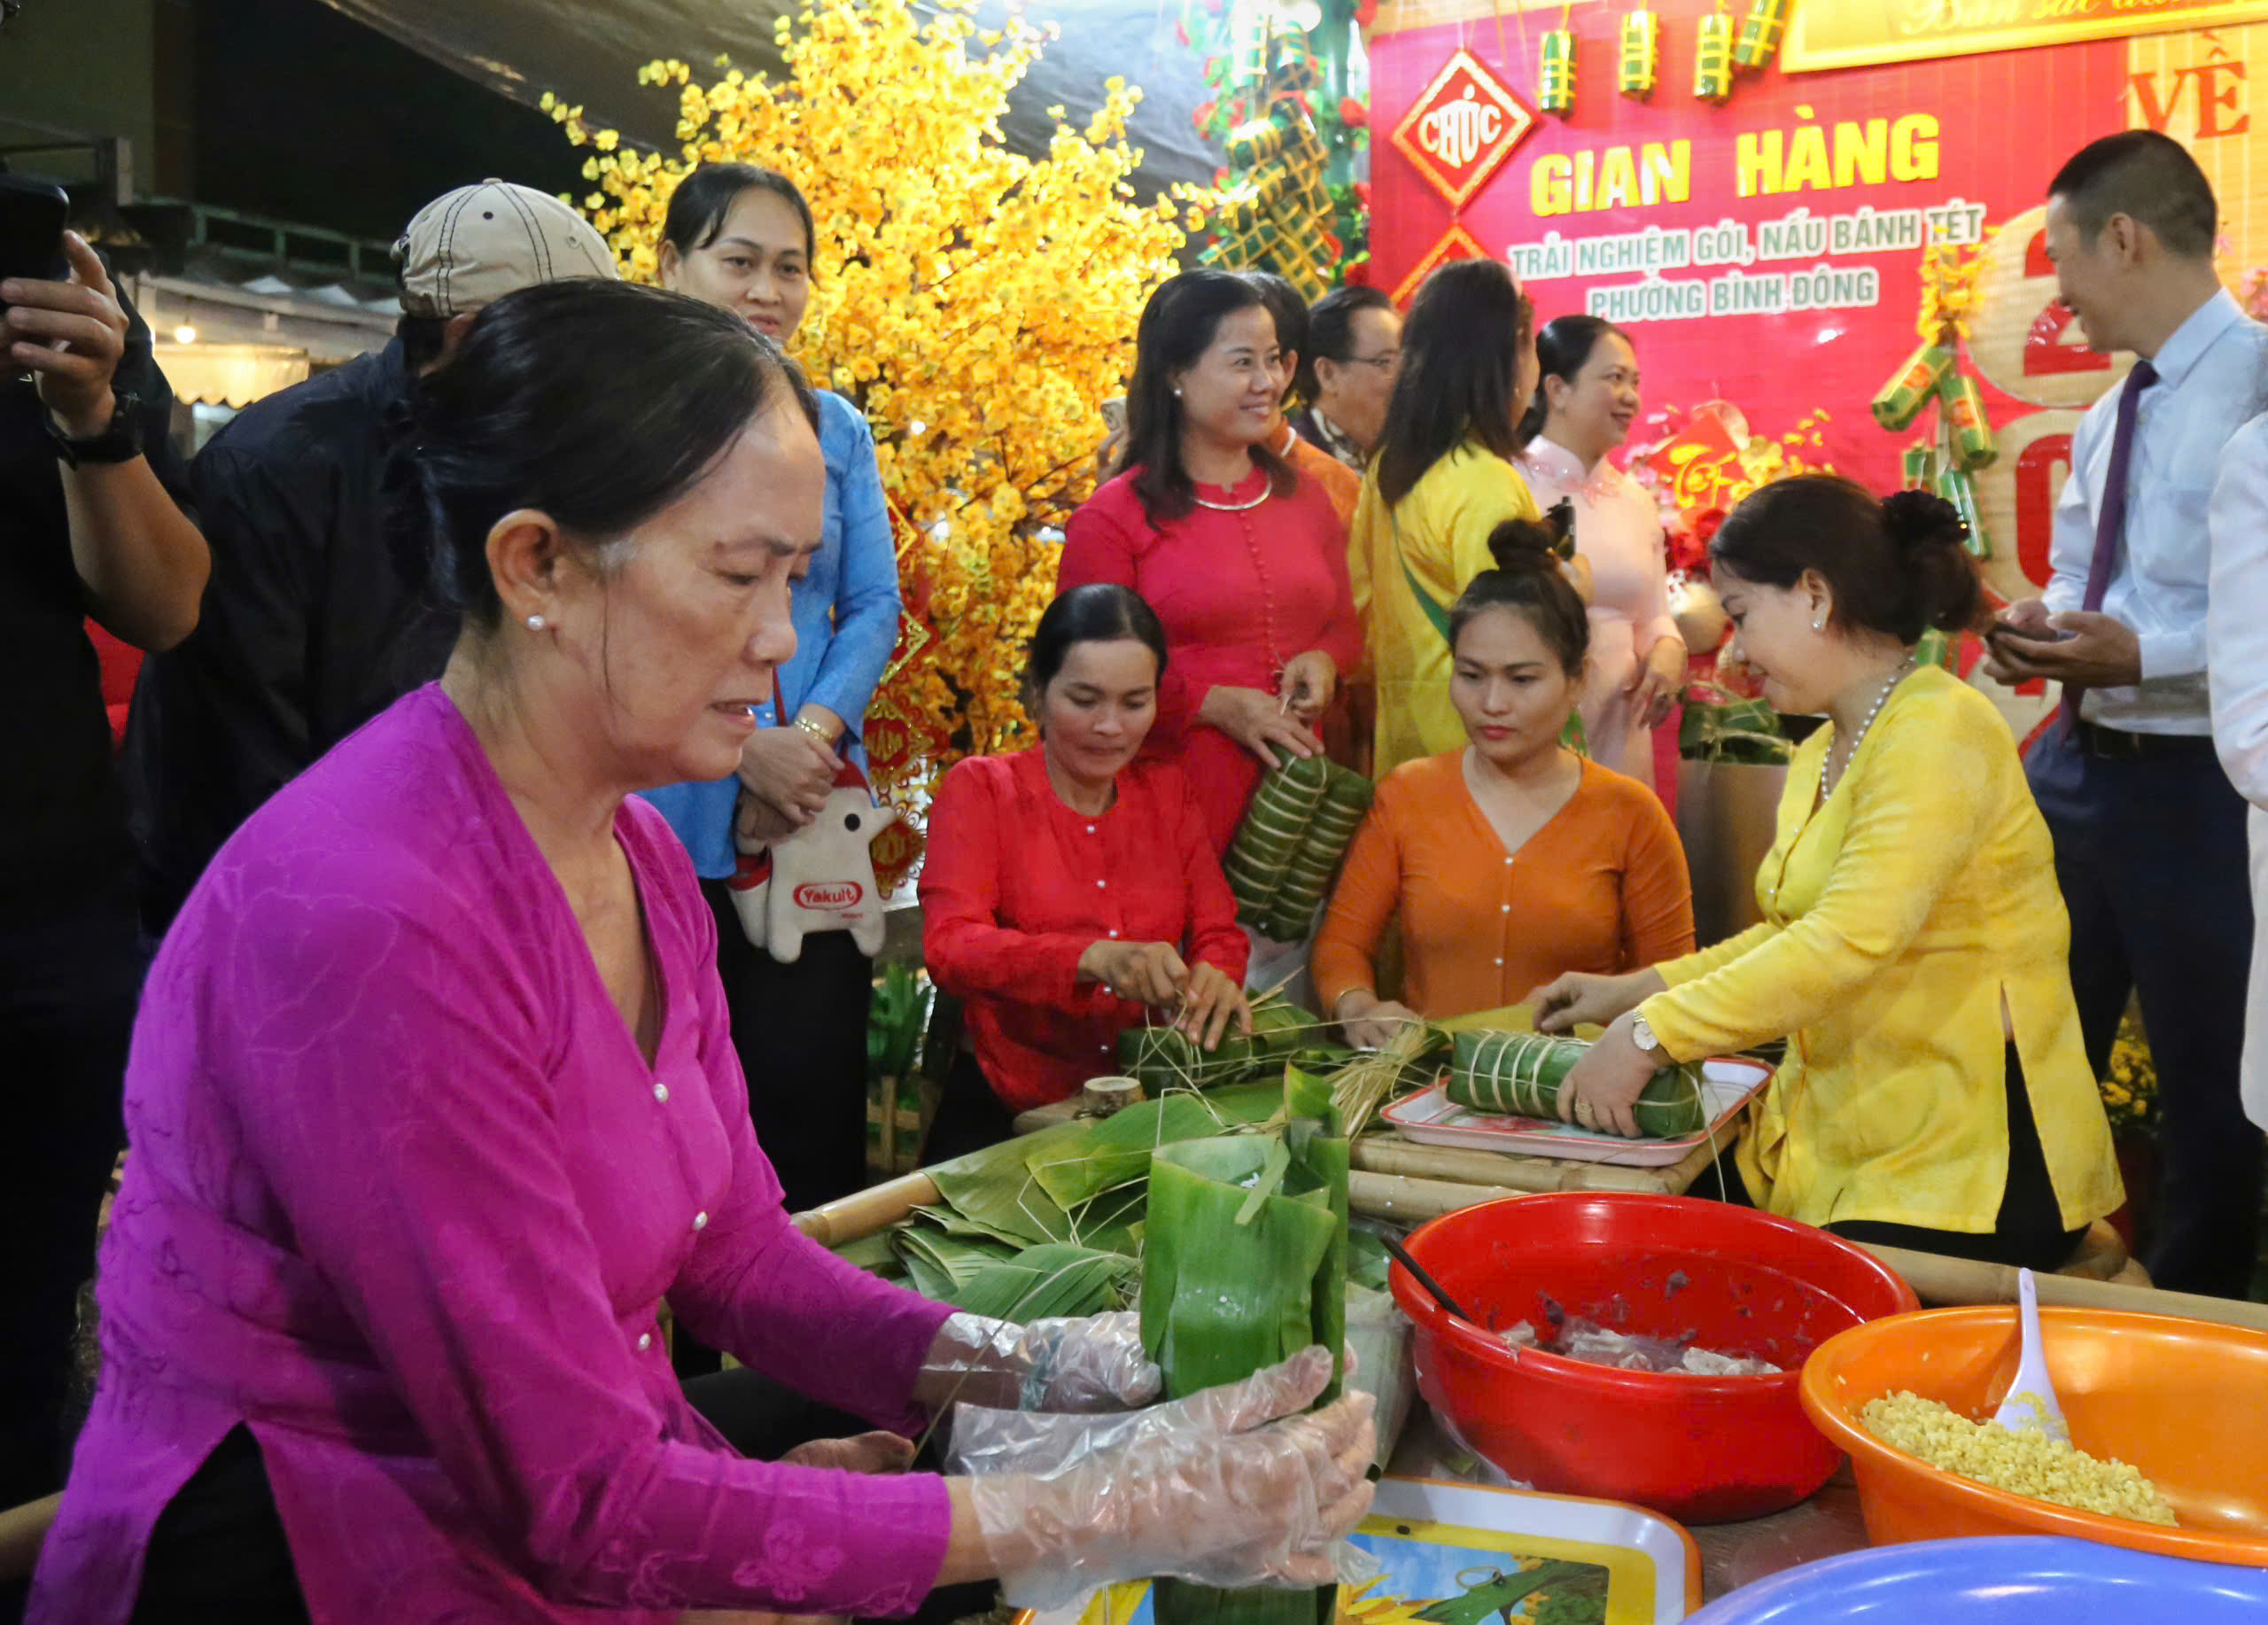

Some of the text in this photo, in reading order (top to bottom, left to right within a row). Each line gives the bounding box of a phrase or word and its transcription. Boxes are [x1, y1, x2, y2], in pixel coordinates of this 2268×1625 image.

[2127, 29, 2250, 139] VỀ
[1419, 83, 1503, 168] CHÚC
[1531, 105, 1940, 216] GIAN HÀNG
[1580, 226, 1685, 277] NGHIỆM
[1763, 208, 1824, 255] NẤU
[1834, 208, 1917, 249] BÁNH
[1591, 267, 1876, 319] PHƯỜNG BÌNH ĐÔNG
[803, 887, 857, 903] Yakult
